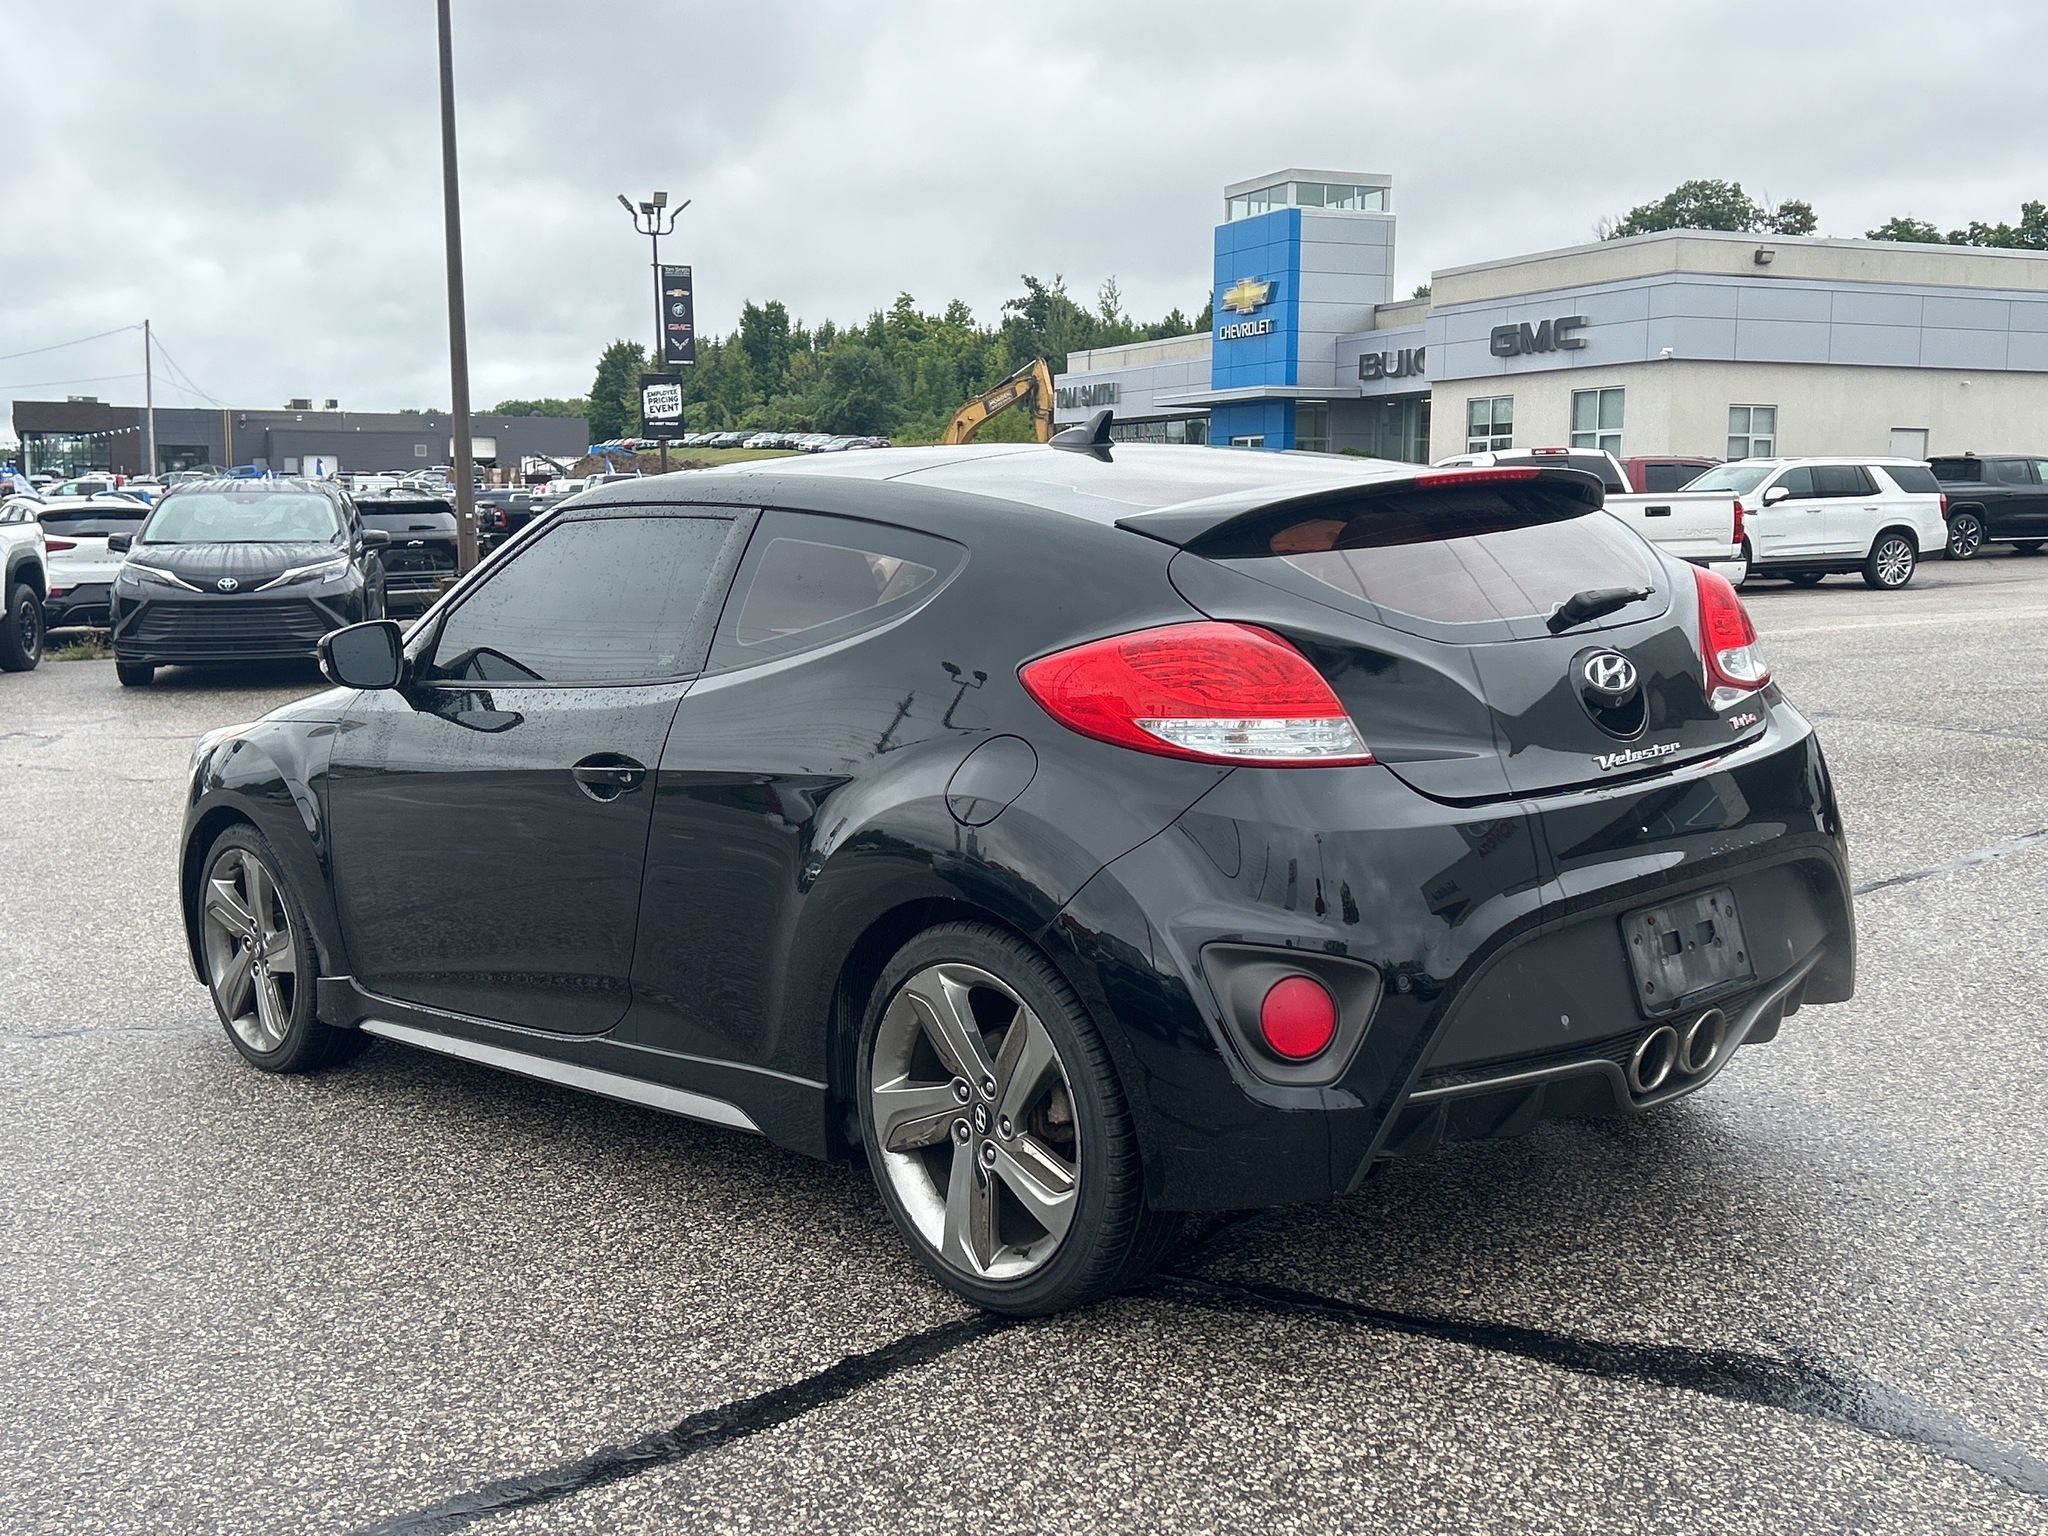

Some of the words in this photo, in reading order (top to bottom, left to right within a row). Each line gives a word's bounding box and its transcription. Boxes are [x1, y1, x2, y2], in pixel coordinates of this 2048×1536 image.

[668, 323, 692, 331] GMC
[1219, 318, 1271, 340] CHEVROLET
[1490, 315, 1587, 357] GMC
[646, 389, 678, 398] EMPLOYEE
[1055, 387, 1081, 409] TOM
[1081, 382, 1119, 407] SMITH
[647, 395, 679, 405] PRICING
[649, 403, 680, 413] EVENT
[1676, 527, 1730, 537] TUNDRA
[1592, 741, 1681, 771] Veloster
